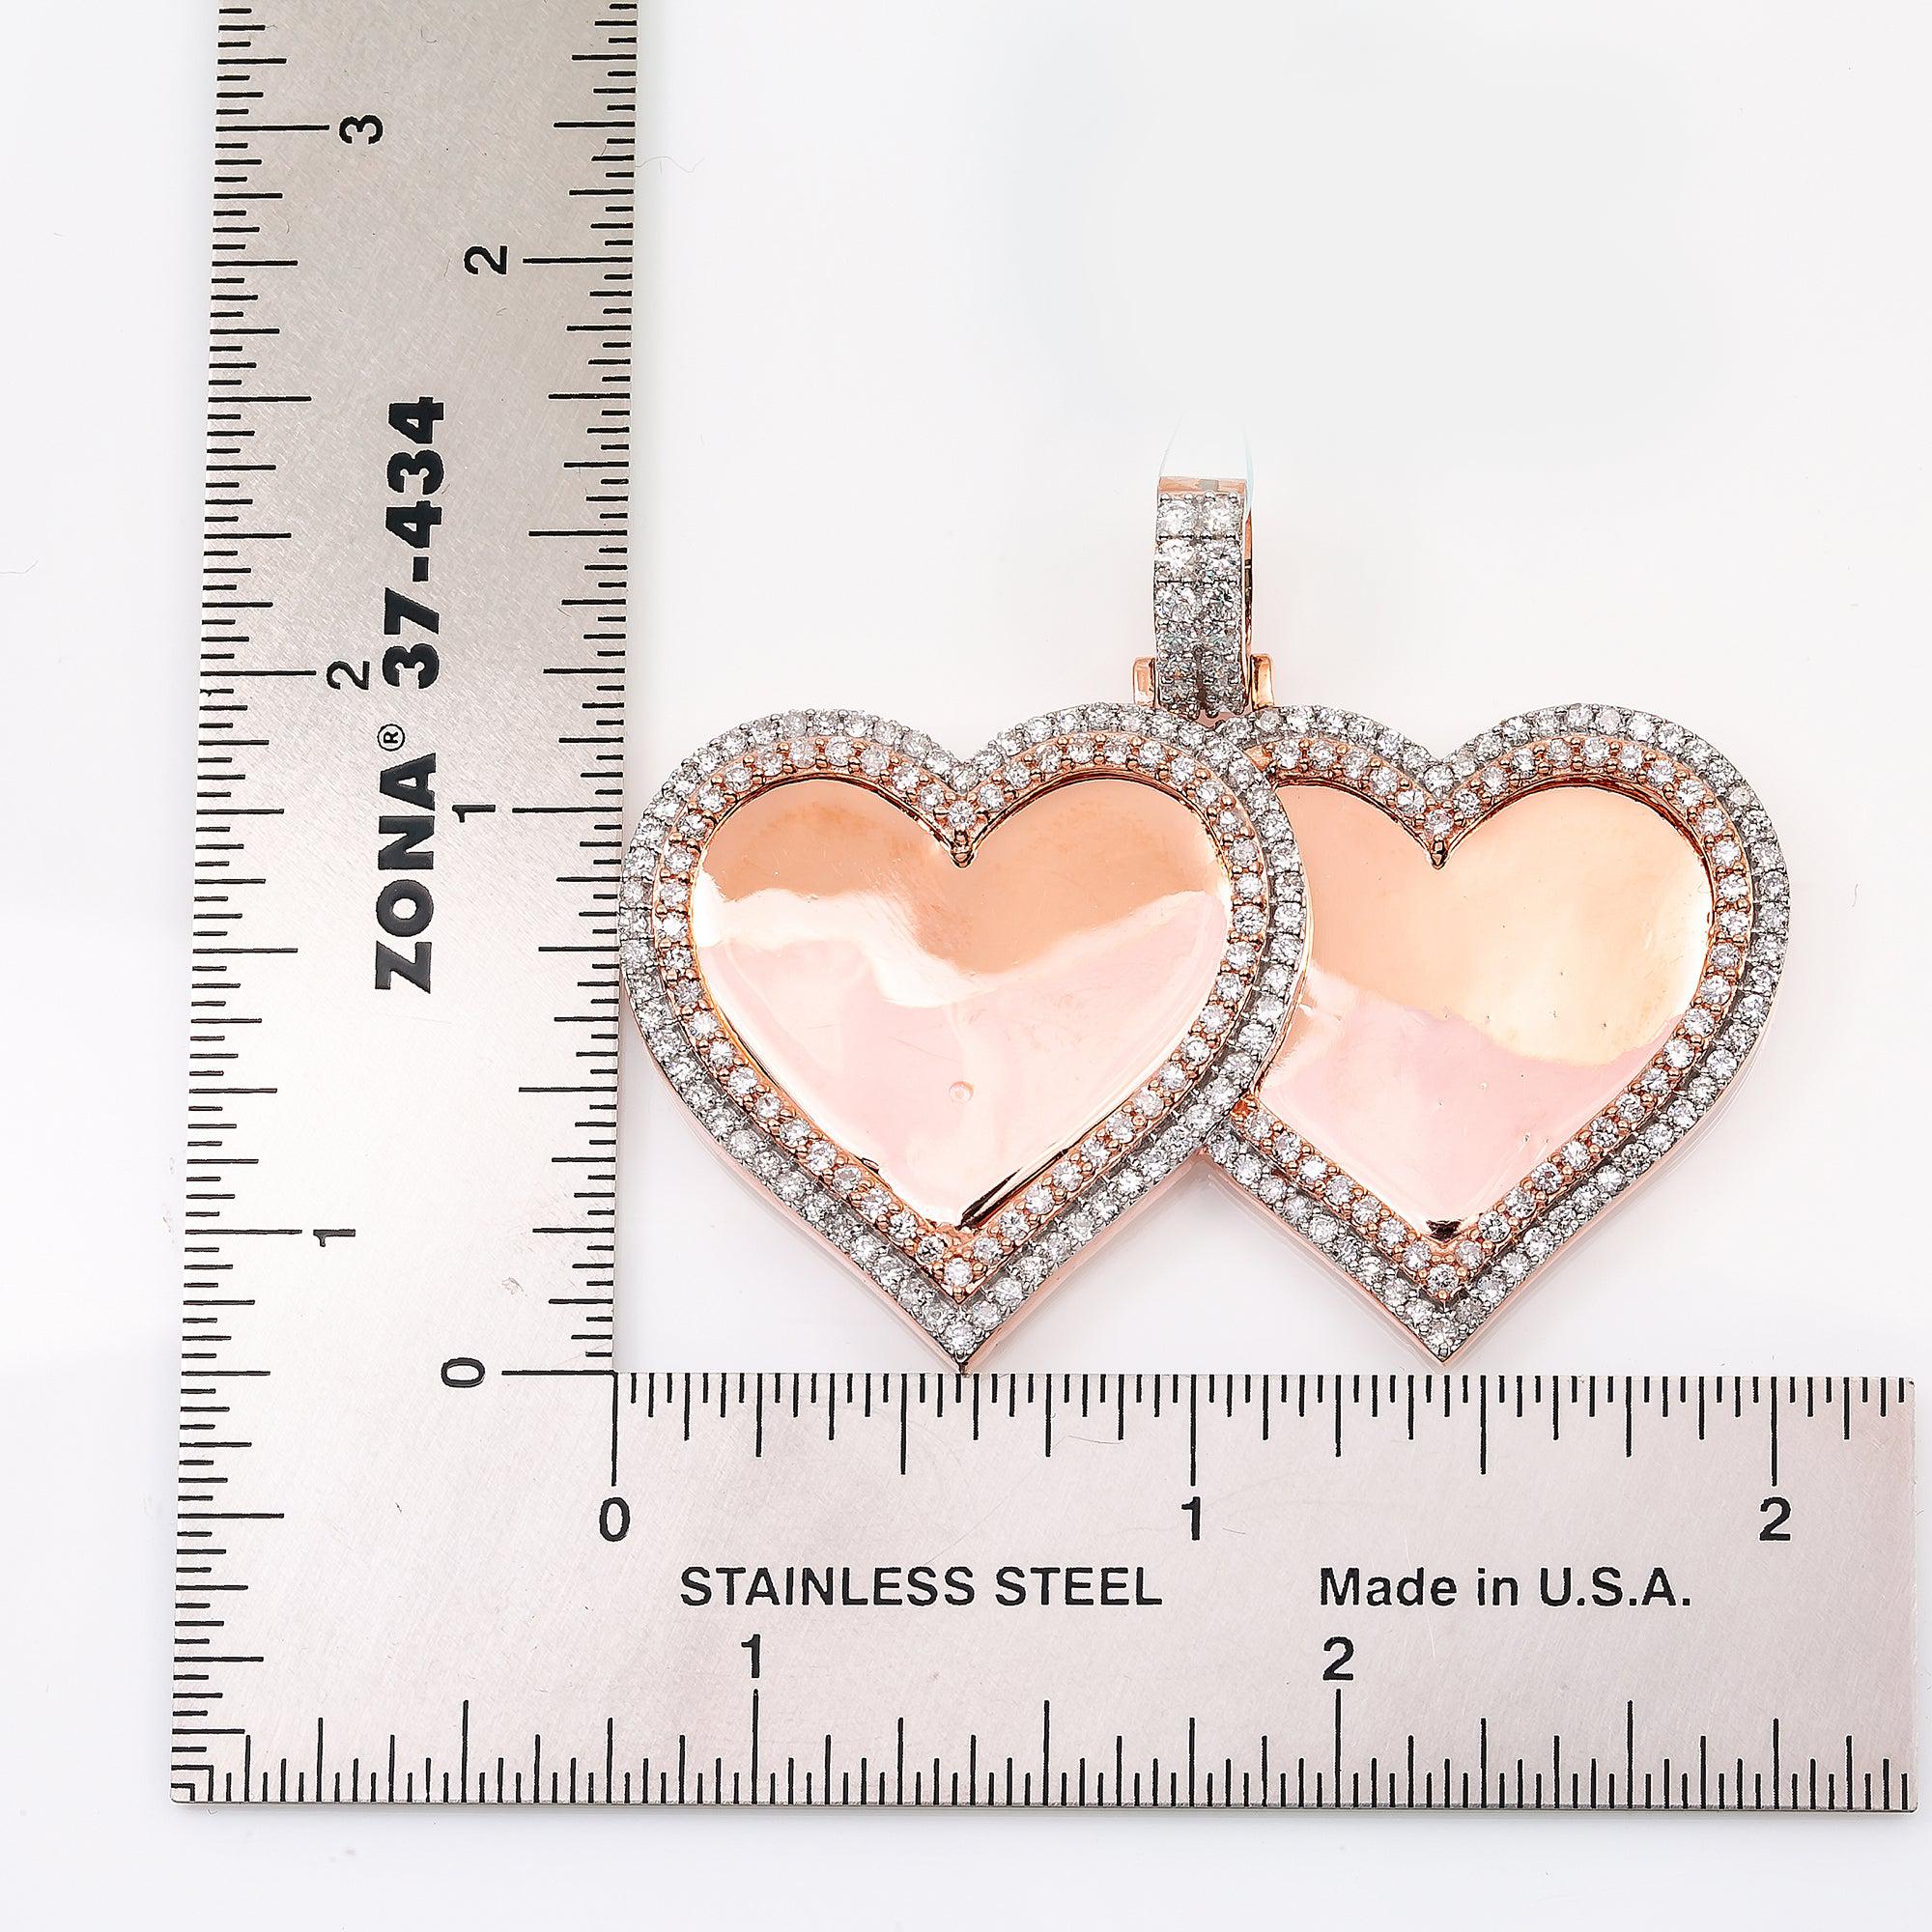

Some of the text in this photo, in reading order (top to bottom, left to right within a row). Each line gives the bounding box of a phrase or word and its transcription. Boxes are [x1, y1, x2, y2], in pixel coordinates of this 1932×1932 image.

[338, 114, 384, 145] 3
[463, 244, 508, 275] 2
[382, 396, 445, 690] 37-434
[326, 660, 371, 691] 2
[451, 804, 497, 824] 1
[312, 1228, 356, 1248] 1
[440, 1356, 486, 1389] 0
[598, 1496, 631, 1543] 0
[1180, 1495, 1201, 1542] 1
[1759, 1496, 1792, 1542] 2
[680, 1566, 1163, 1607] STAINLESS STEEL
[1320, 1566, 1690, 1607] Made in U.S.A.
[740, 1634, 761, 1679] 1
[1322, 1635, 1354, 1681] 2
